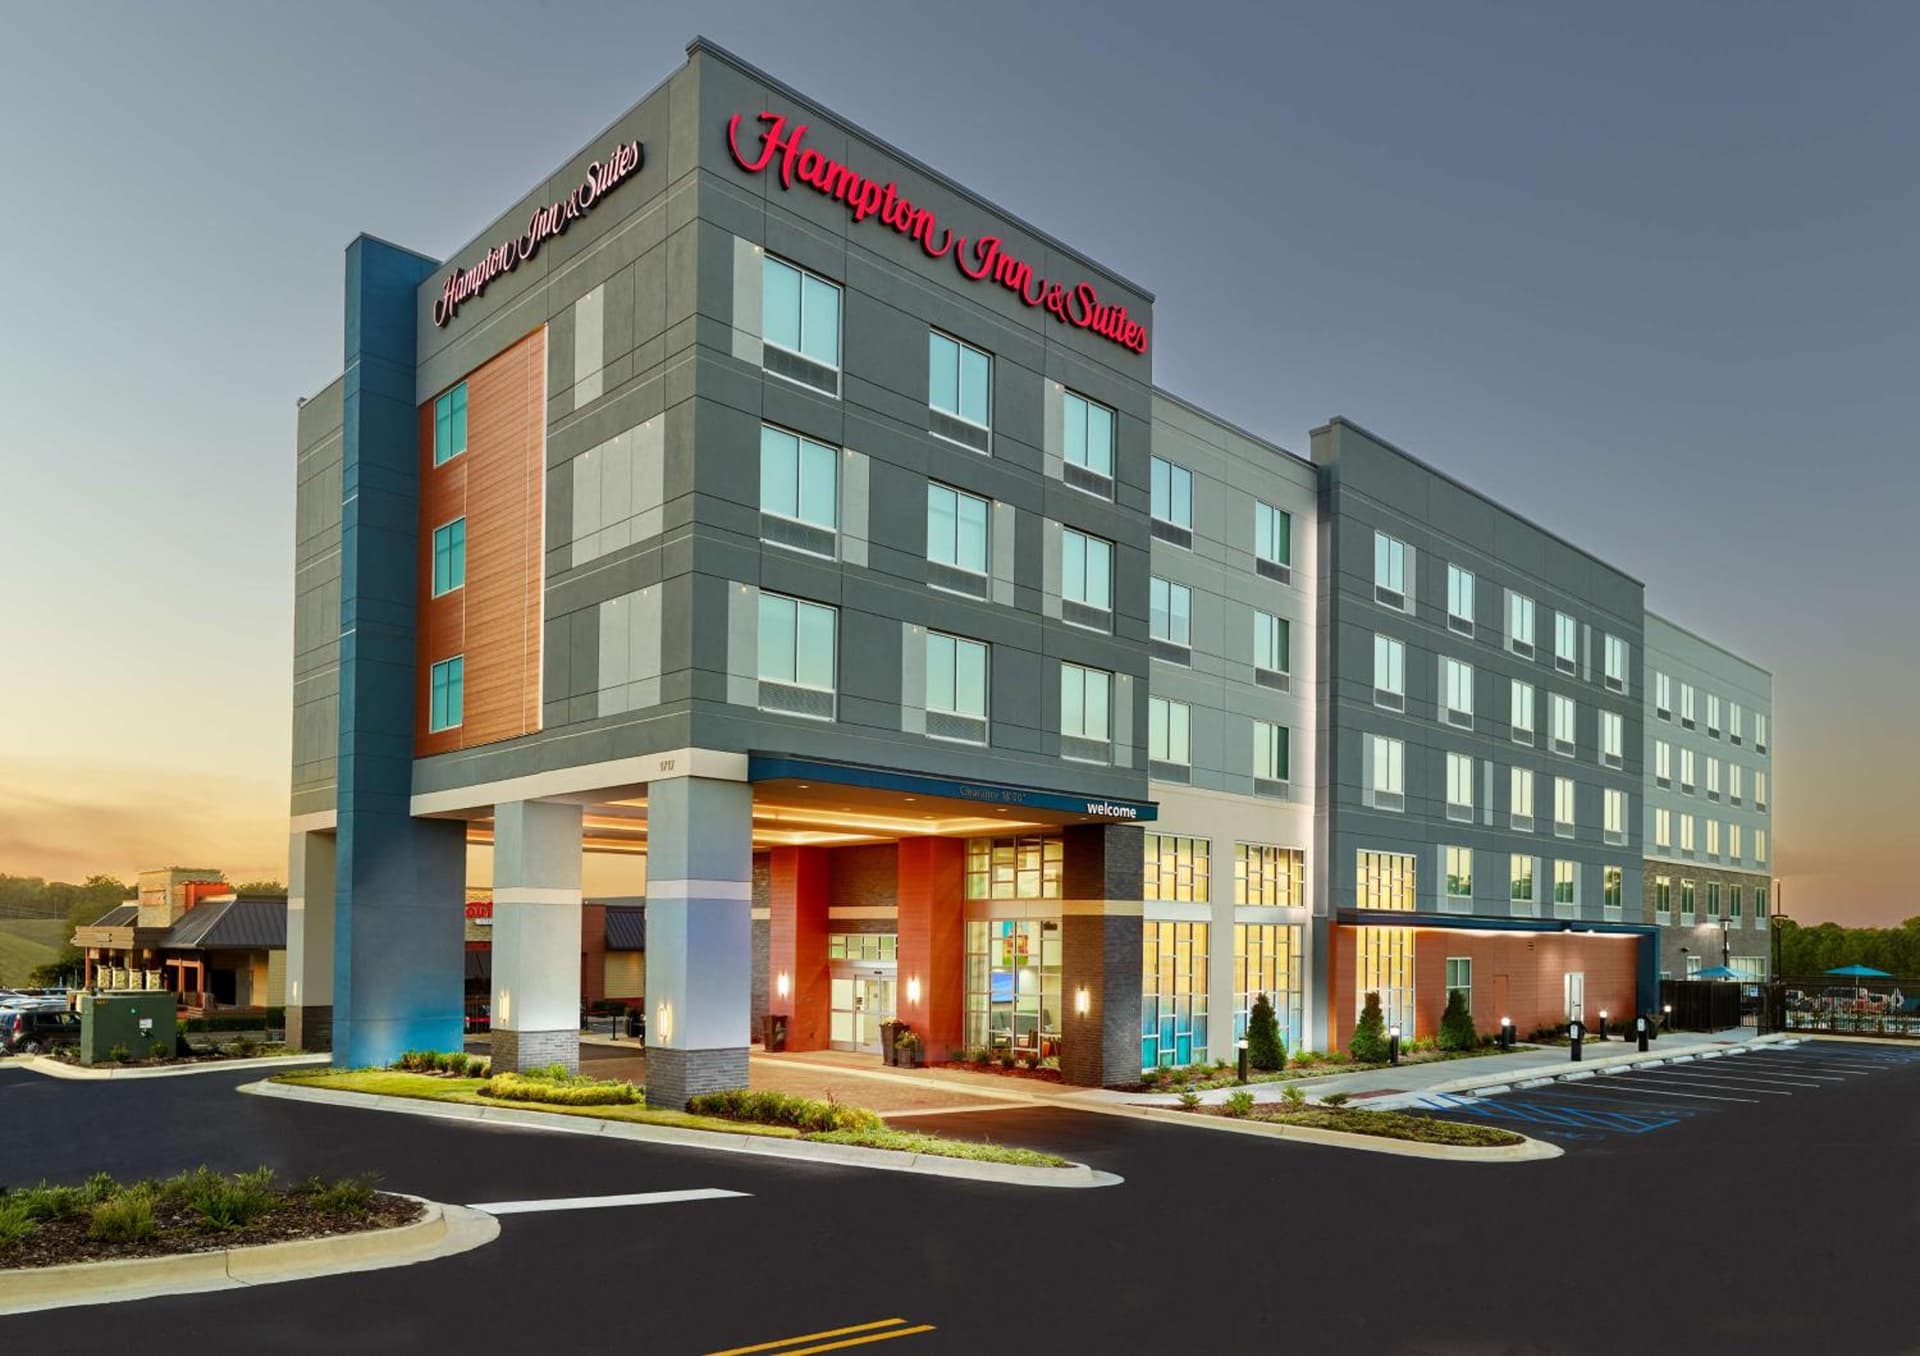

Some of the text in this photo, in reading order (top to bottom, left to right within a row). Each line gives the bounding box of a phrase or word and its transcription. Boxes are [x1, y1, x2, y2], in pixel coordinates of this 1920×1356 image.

[433, 140, 641, 327] Hampton Inn & Suites
[728, 111, 1148, 354] Hampton Inn & Suites
[1087, 801, 1137, 819] welcome
